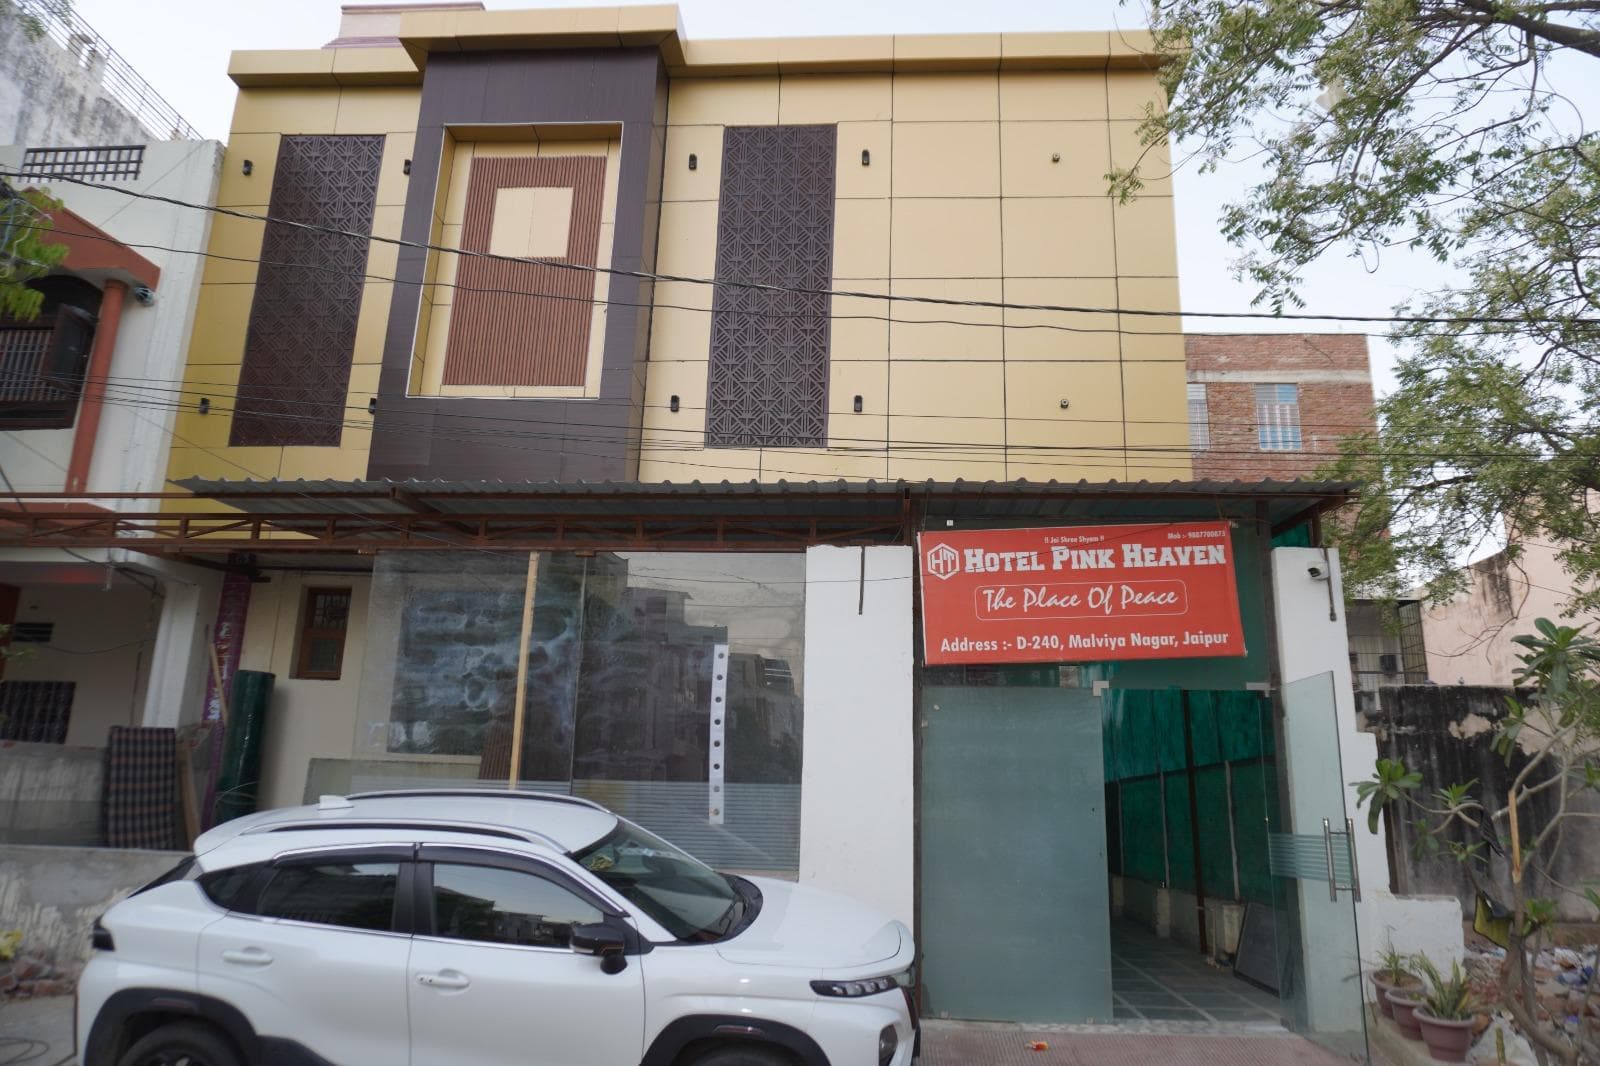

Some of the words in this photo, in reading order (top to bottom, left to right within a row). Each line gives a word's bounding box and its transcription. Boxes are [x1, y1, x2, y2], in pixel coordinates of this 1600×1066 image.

[964, 548, 1045, 573] HOTEL
[1051, 545, 1115, 570] PINK
[1122, 543, 1226, 567] HEAVEN
[983, 587, 1016, 612] The
[1023, 586, 1081, 612] Place
[1088, 585, 1113, 615] Of
[1120, 584, 1178, 610] Peace
[940, 637, 998, 652] Address
[1017, 635, 1064, 650] D-240,
[1069, 633, 1125, 650] Malviya
[1131, 632, 1178, 649] Nagar,
[1183, 631, 1228, 648] Jaipur
